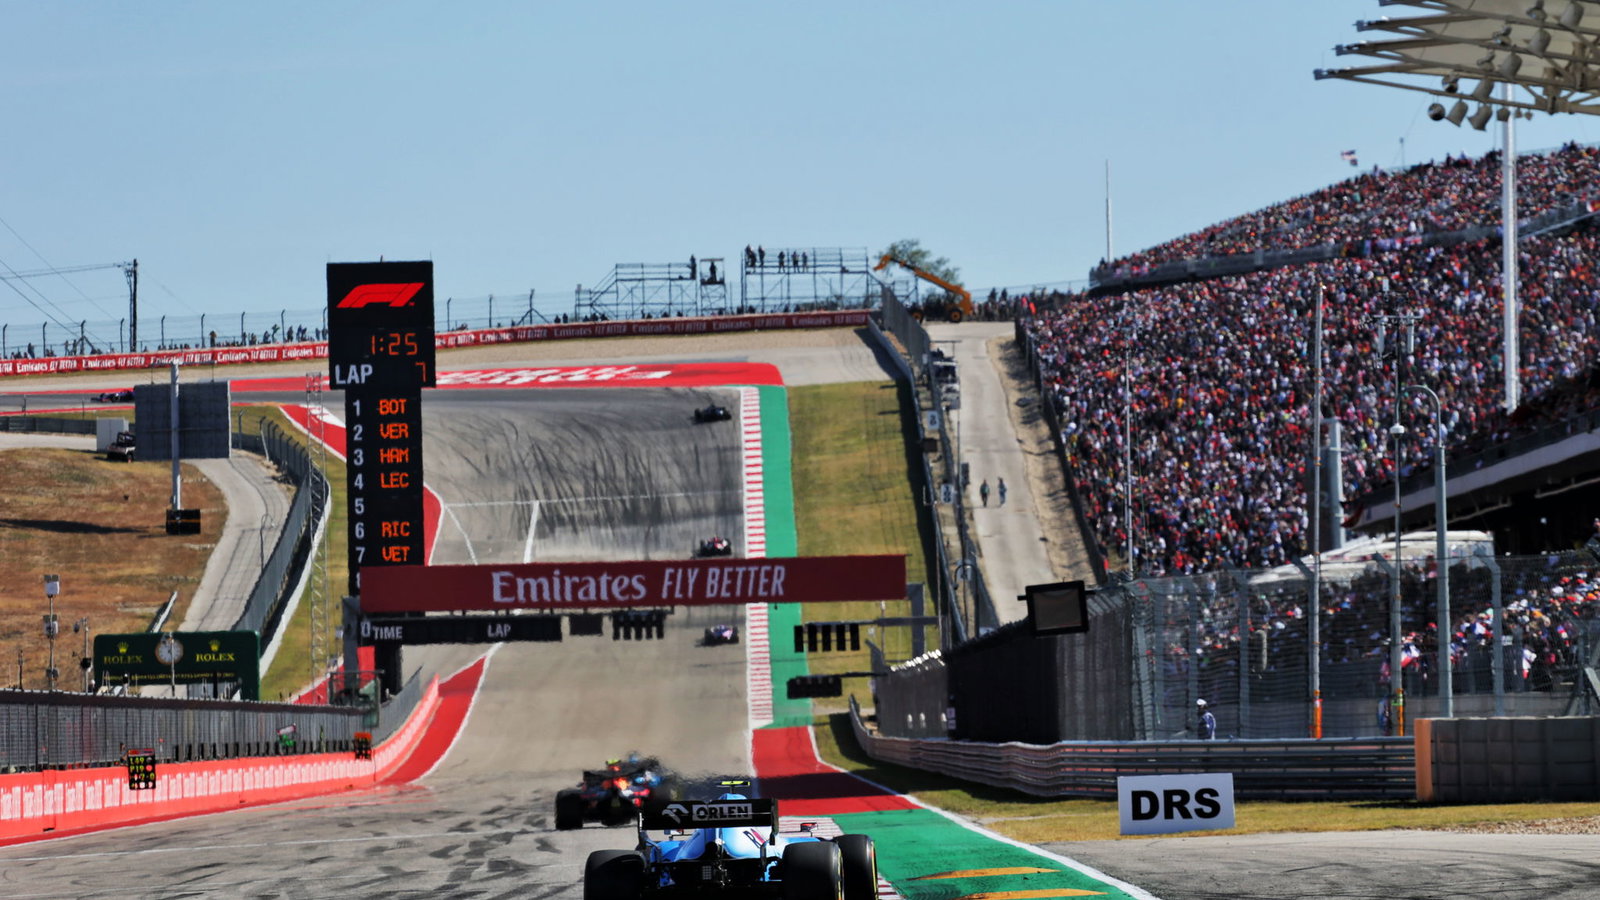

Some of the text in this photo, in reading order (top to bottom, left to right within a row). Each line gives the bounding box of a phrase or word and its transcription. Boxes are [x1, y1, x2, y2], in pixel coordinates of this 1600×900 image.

[372, 333, 418, 355] 1:25
[335, 364, 373, 385] LAP
[415, 362, 426, 383] 7
[353, 399, 407, 416] 1 BOT
[353, 423, 409, 441] 2 VER
[353, 448, 409, 466] 3 HAM
[354, 473, 410, 490] 4 LEC
[354, 498, 365, 514] 5
[355, 522, 410, 539] 6 RIC
[356, 547, 410, 563] 7 VET
[491, 565, 786, 603] Emirates FLY BETTER
[373, 624, 511, 640] TIME LAP
[103, 655, 142, 665] ROLEX
[195, 653, 235, 663] ROLEX
[696, 806, 749, 819] ORLEN
[1131, 788, 1221, 821] DRS
